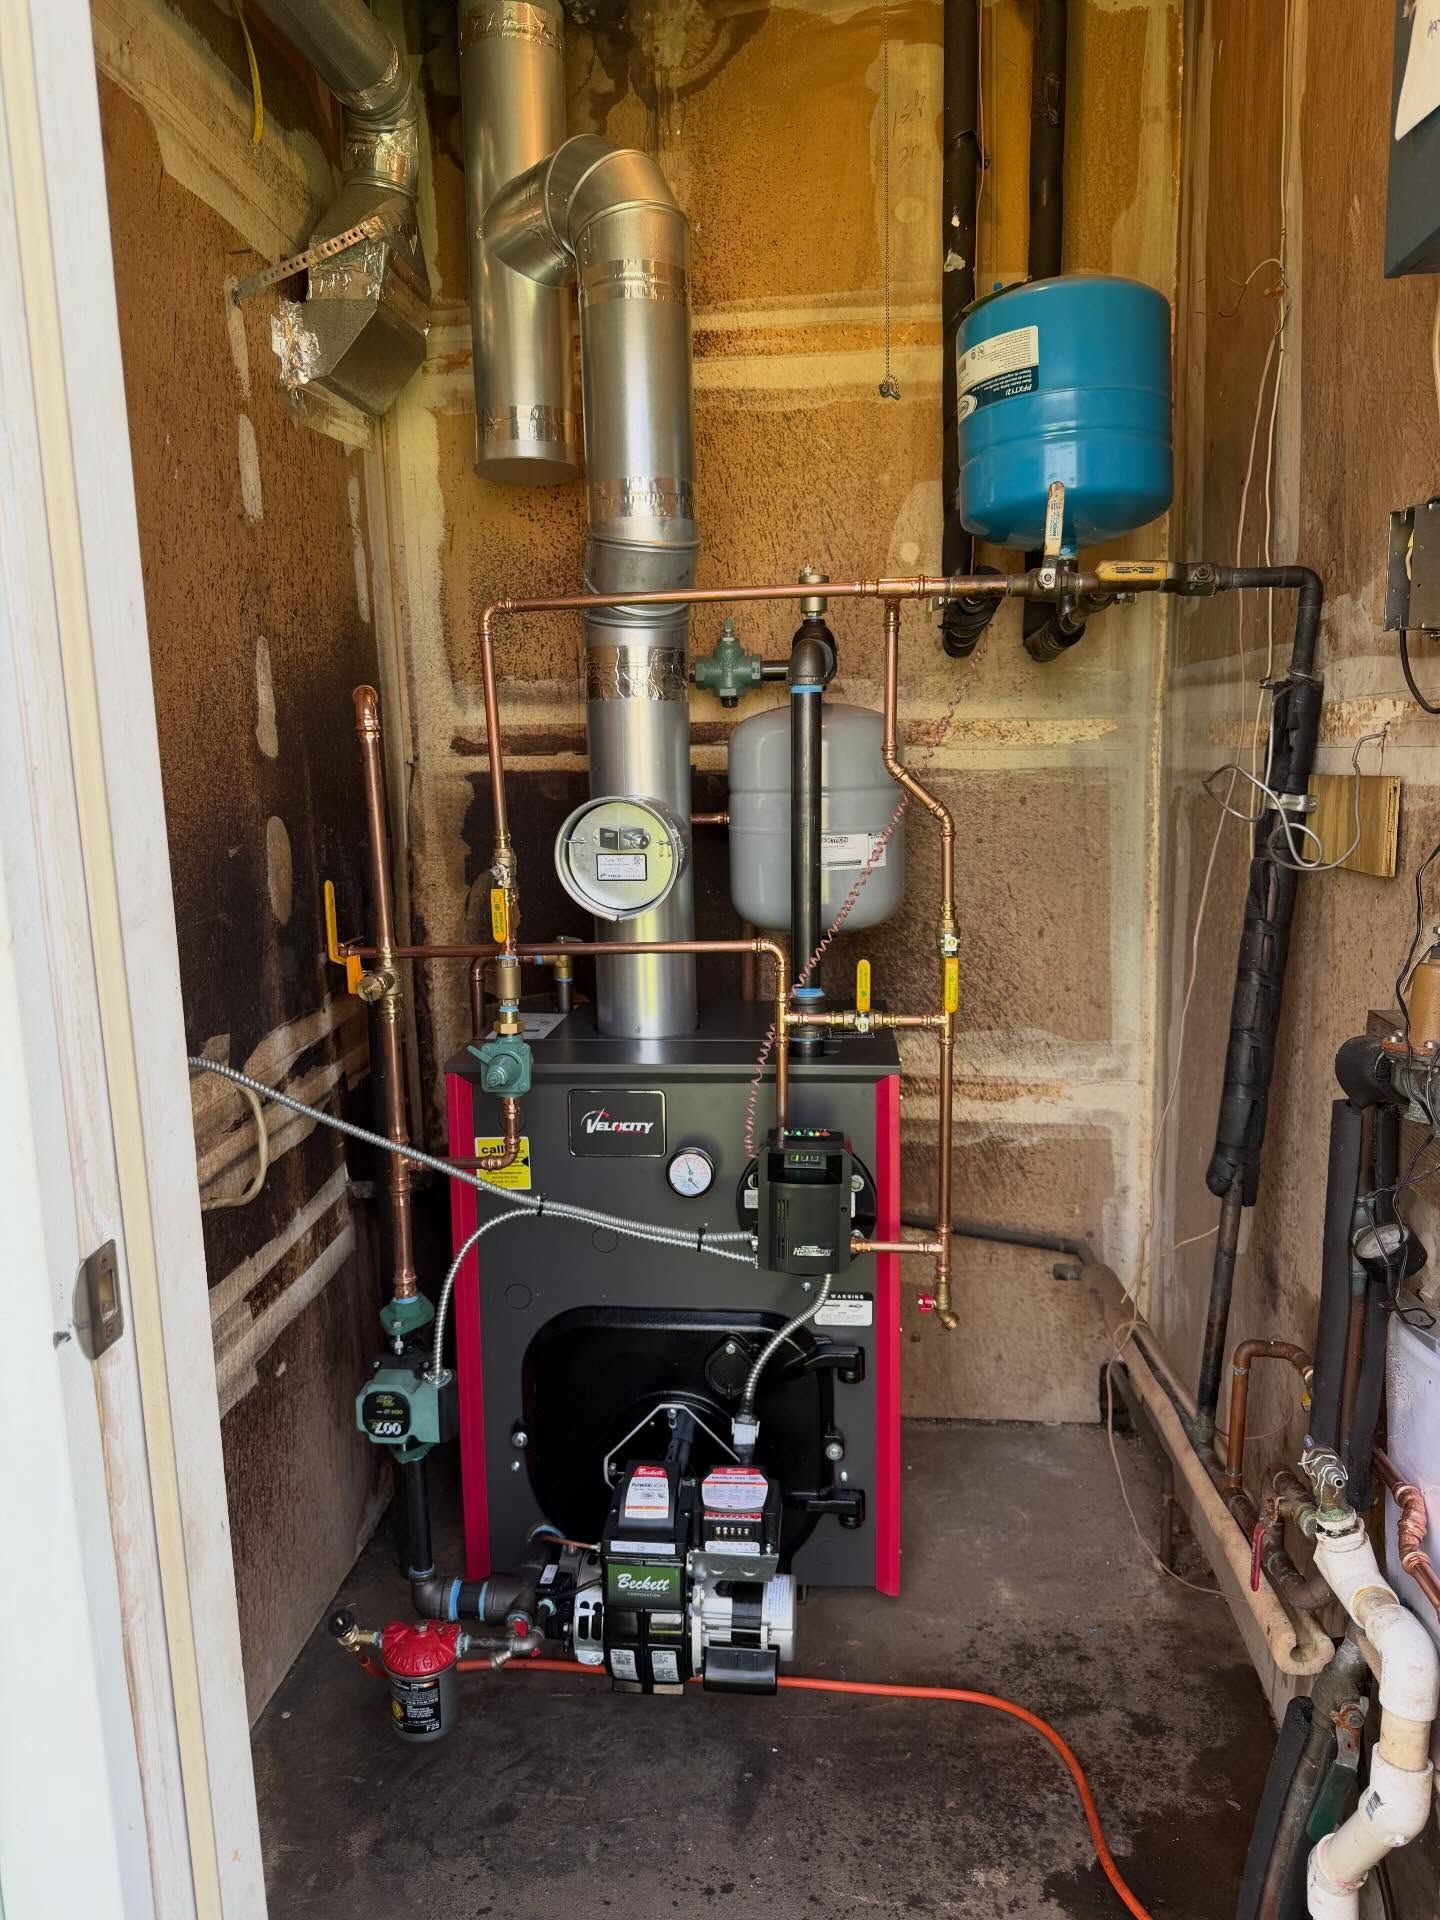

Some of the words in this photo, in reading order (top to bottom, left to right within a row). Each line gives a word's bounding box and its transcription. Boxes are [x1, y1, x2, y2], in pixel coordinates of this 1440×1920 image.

[586, 1109, 654, 1134] VELOCITY
[481, 1145, 504, 1154] call
[374, 1422, 402, 1435] 007
[617, 1573, 670, 1592] Beckett
[426, 1721, 440, 1732] F25
